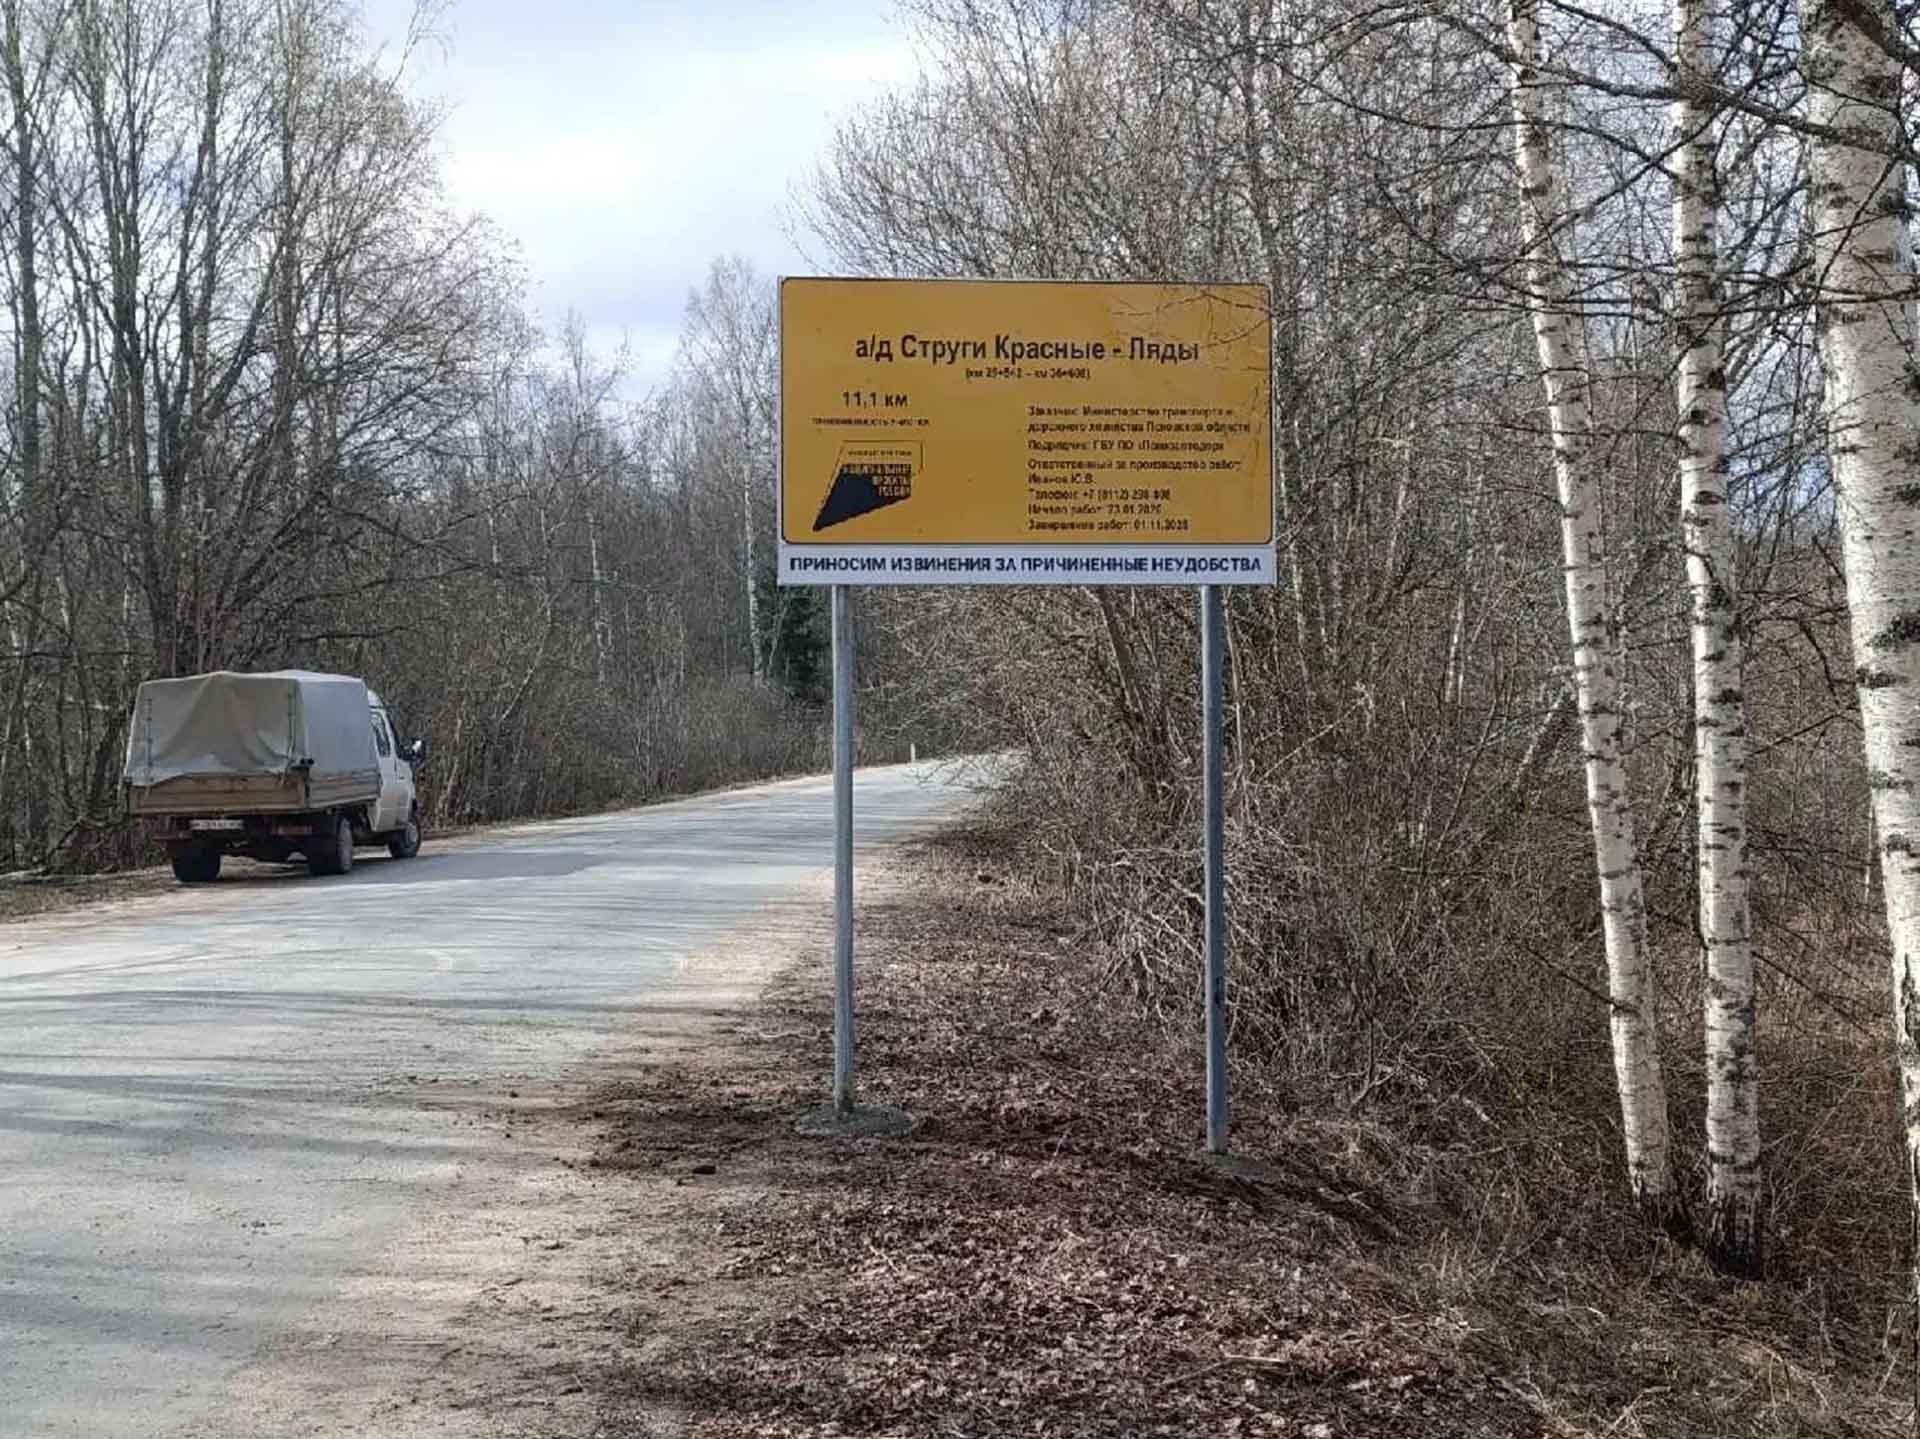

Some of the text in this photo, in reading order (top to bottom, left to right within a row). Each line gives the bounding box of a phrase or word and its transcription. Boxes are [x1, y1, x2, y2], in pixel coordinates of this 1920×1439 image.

[856, 335, 894, 364] а/д
[900, 334, 986, 365] Струги
[995, 335, 1104, 365] Красные
[1128, 338, 1199, 365] Ляды
[842, 391, 909, 409] 11,1 км
[1092, 440, 1115, 451] ГБУ
[1117, 440, 1135, 450] ПО
[790, 557, 1263, 573] ПРИНОСИМ ИЗВИНЕНИЯ ЗА ПРИЧИНЕННЫЕ НЕУДОБСТВА
